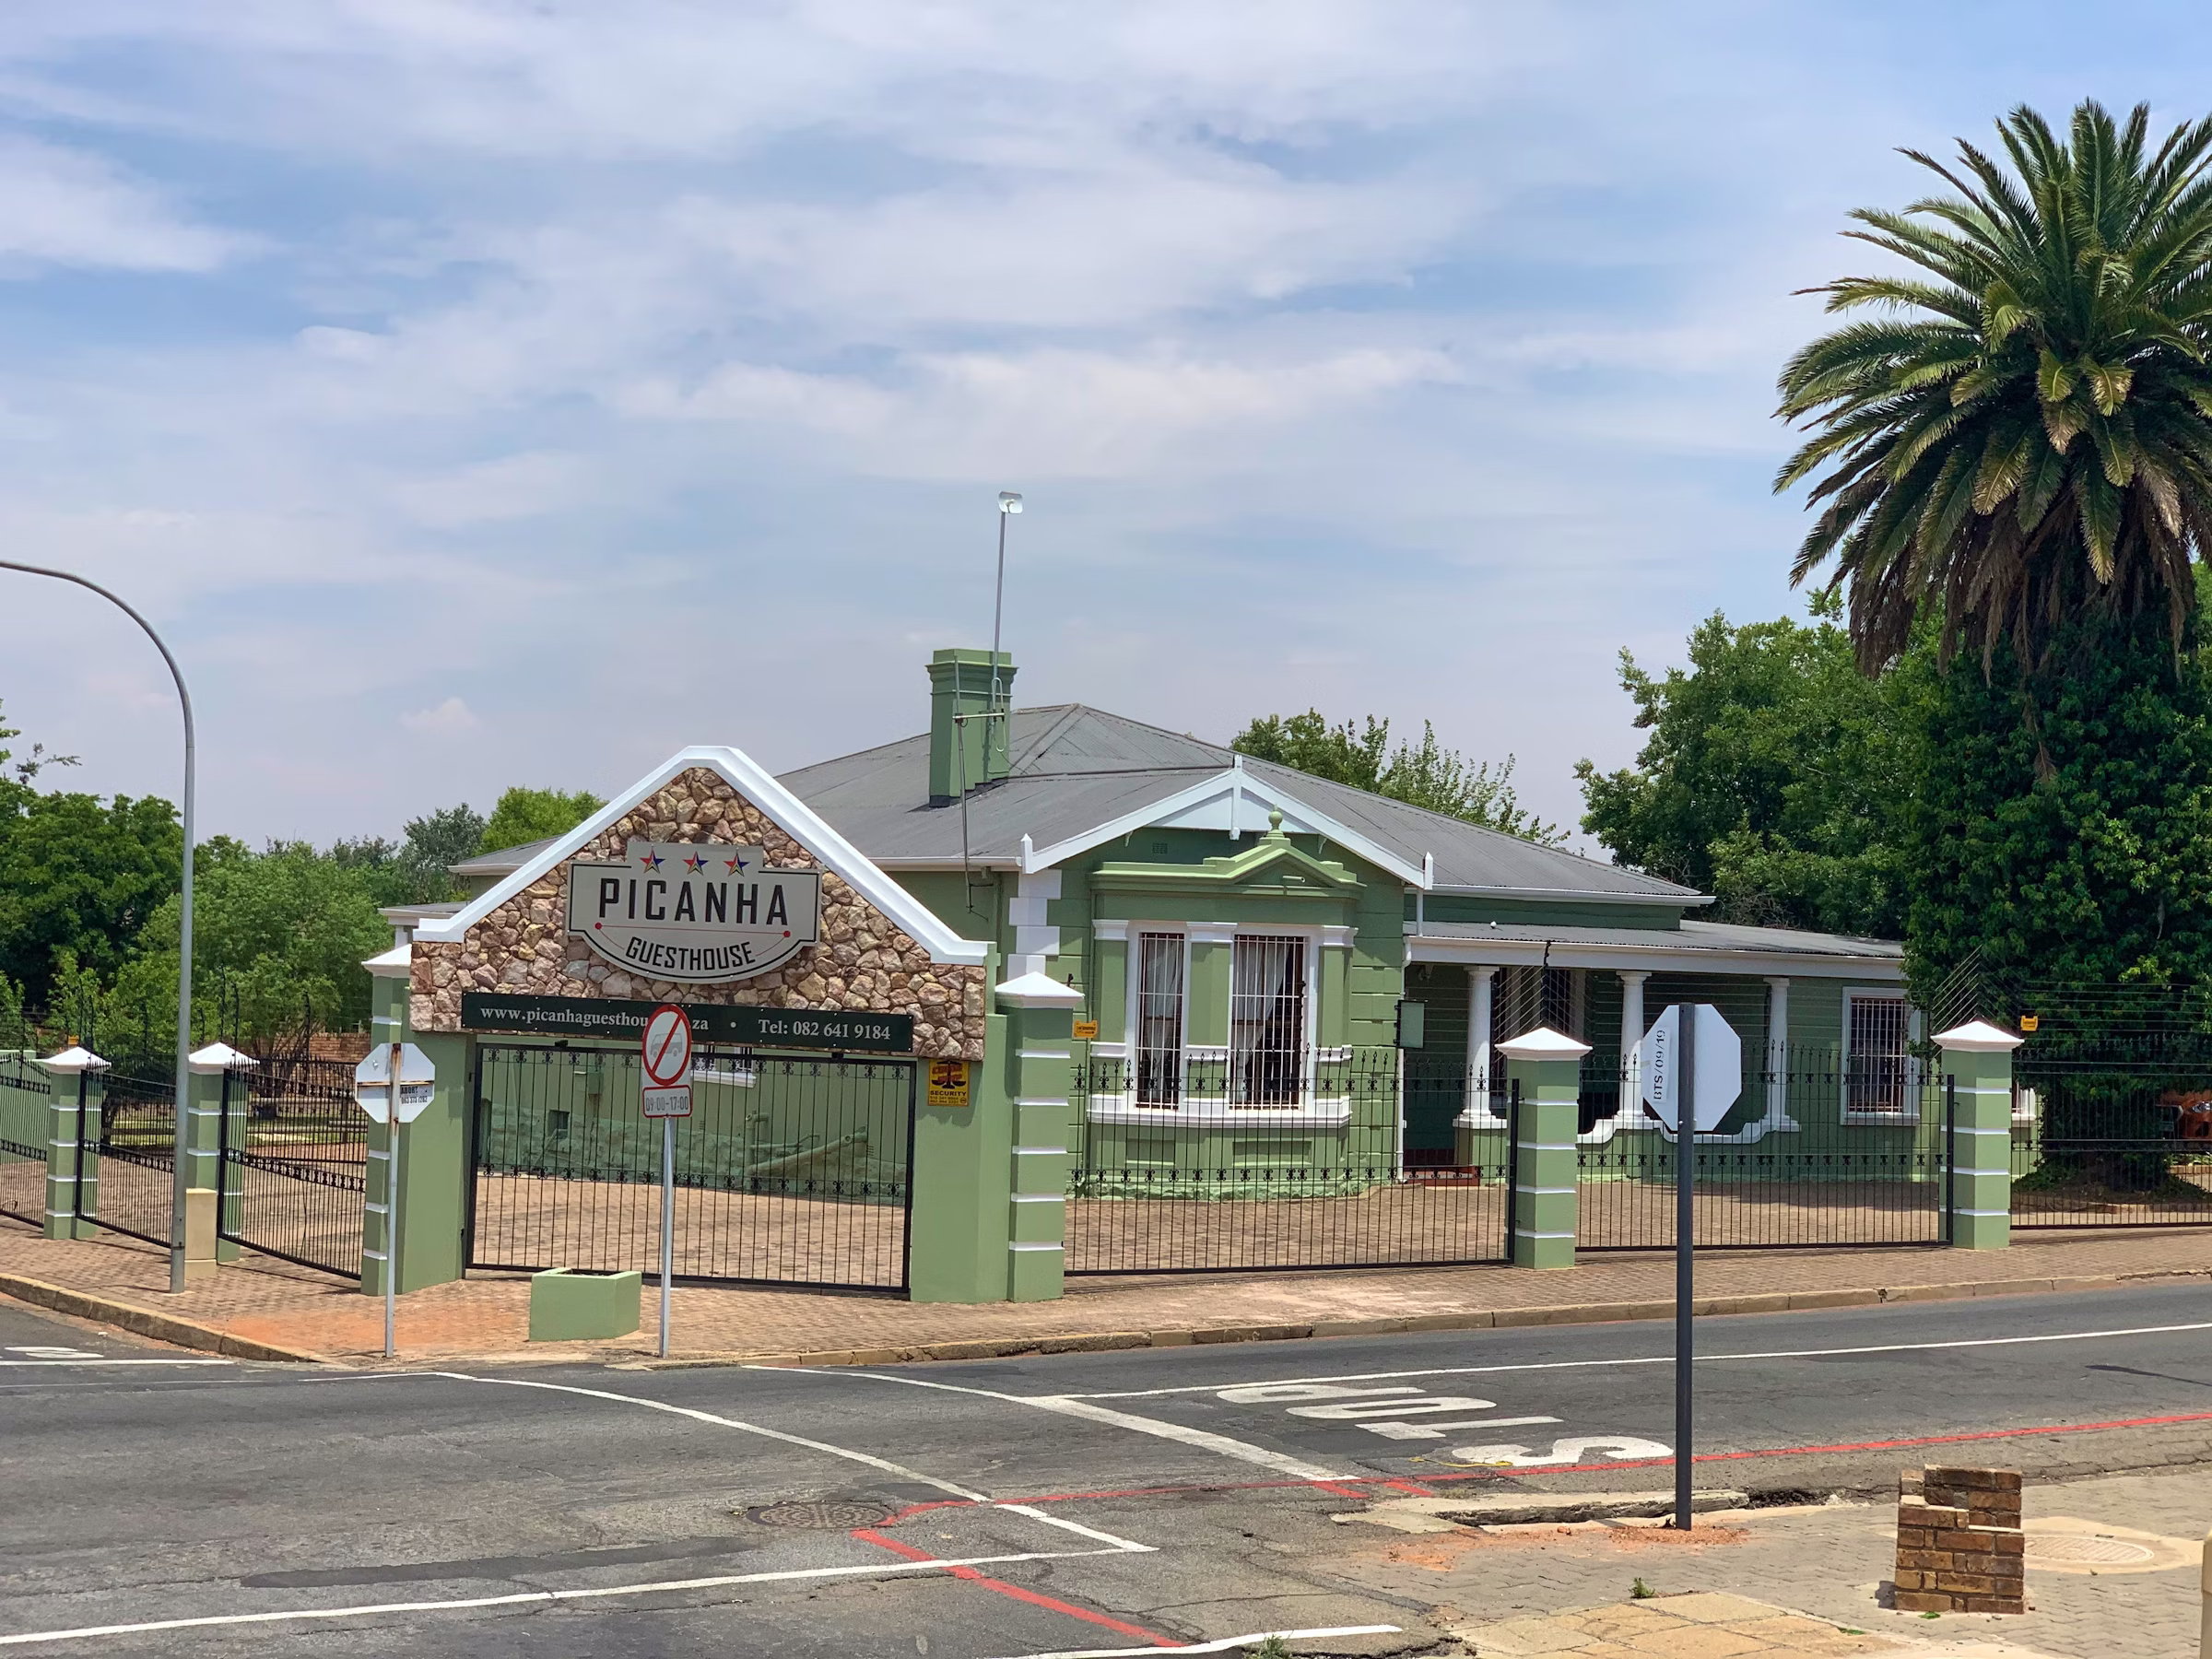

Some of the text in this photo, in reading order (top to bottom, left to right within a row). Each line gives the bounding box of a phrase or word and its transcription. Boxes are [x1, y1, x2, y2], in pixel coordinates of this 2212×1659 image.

[599, 877, 788, 925] PICANHA
[626, 936, 756, 971] GUESTHOUSE
[759, 1019, 788, 1035] Tel:
[793, 1020, 819, 1037] 082
[823, 1022, 849, 1038] 641
[854, 1024, 891, 1041] 9184
[1217, 1385, 1674, 1467] STOP
